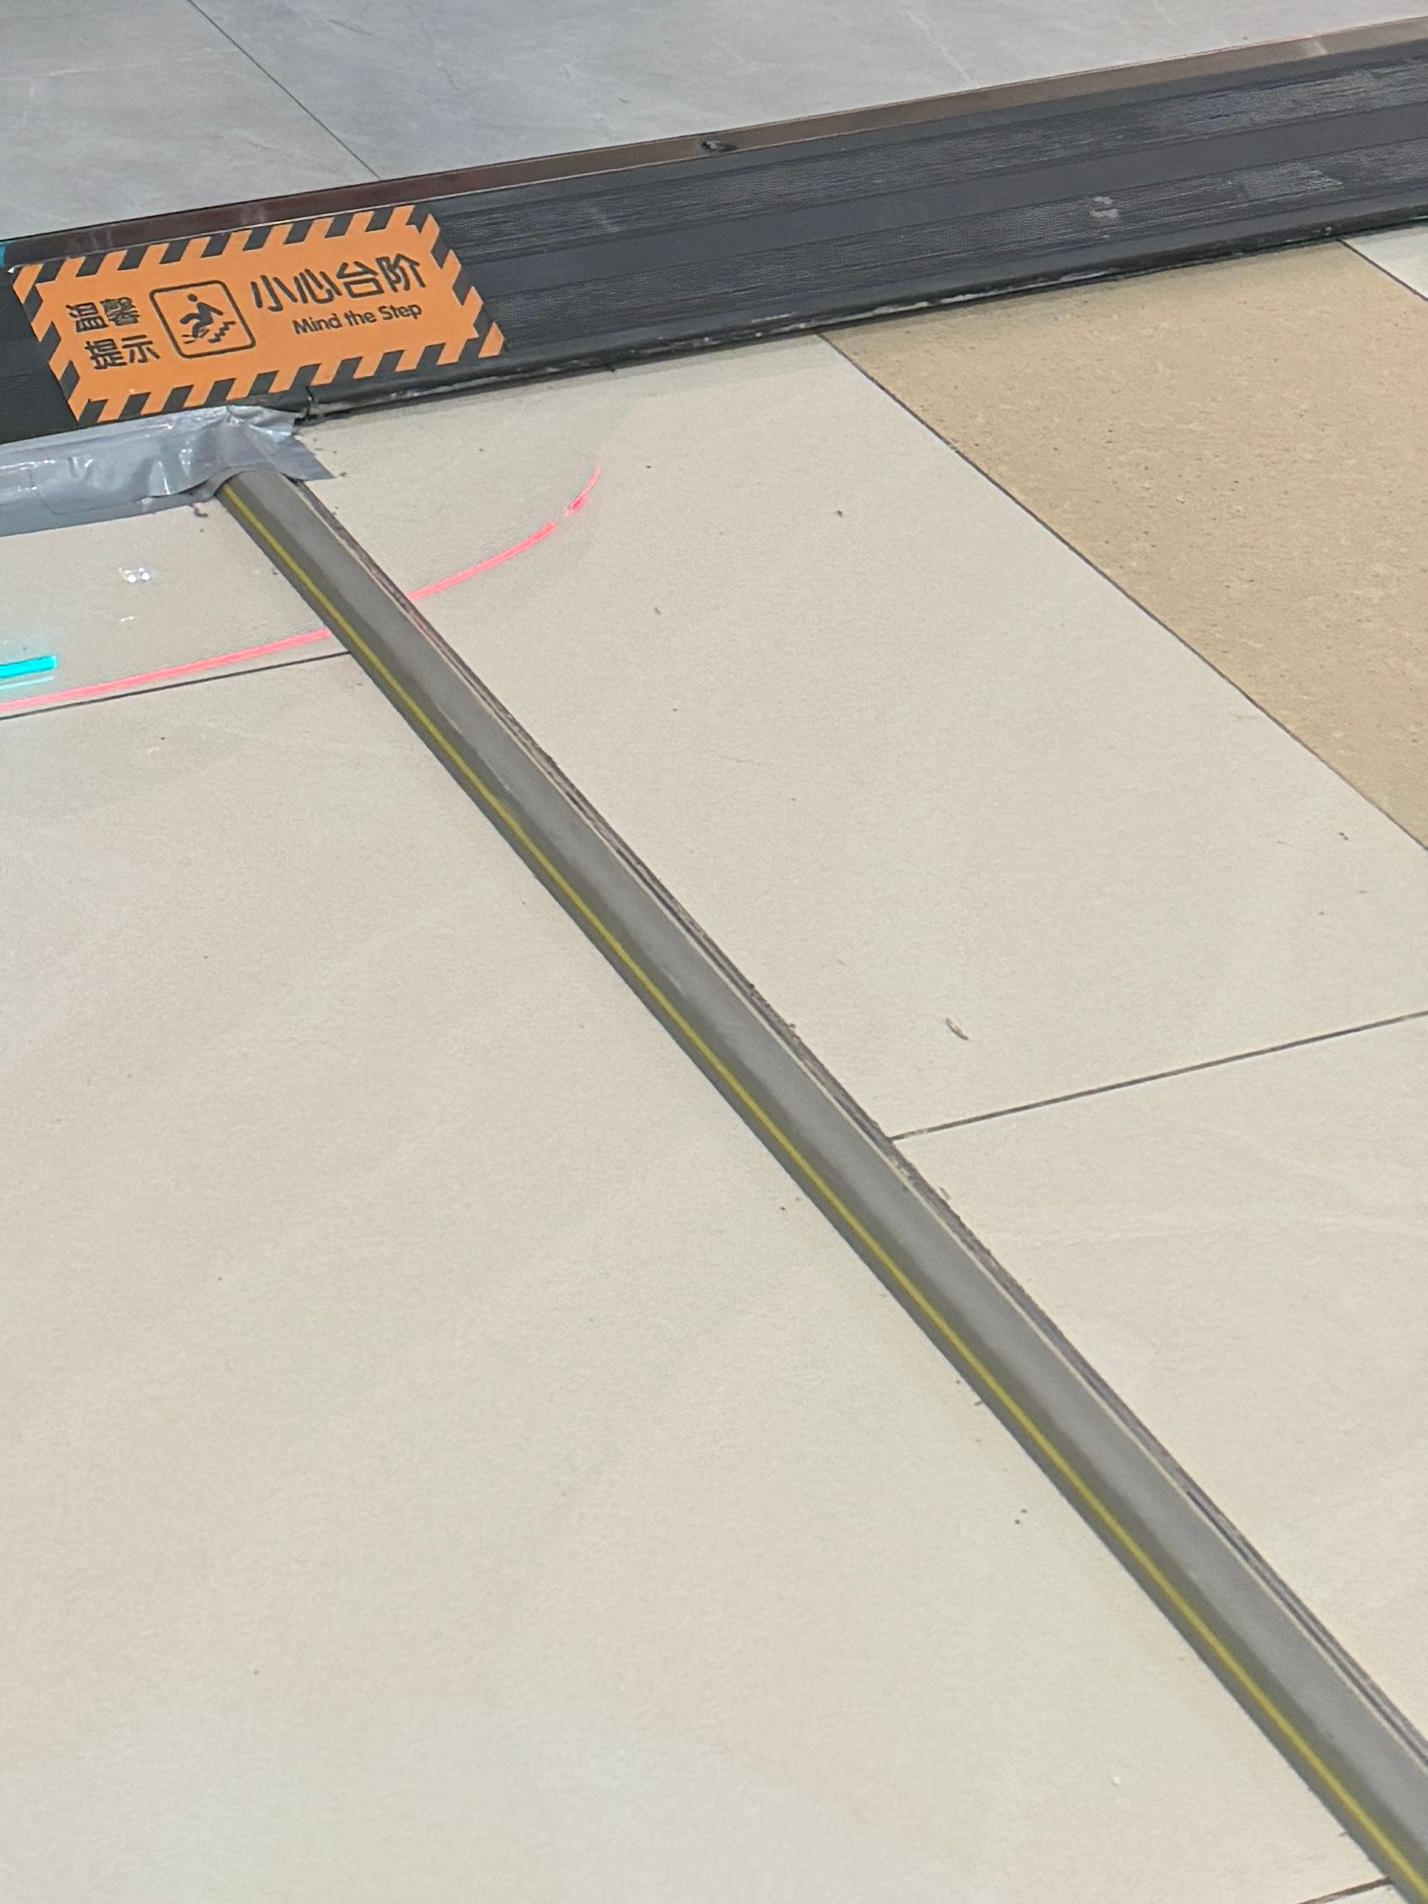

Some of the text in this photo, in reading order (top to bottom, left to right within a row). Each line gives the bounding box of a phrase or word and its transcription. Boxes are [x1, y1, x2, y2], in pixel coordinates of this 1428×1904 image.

[249, 253, 427, 312] 小心台阶
[65, 296, 142, 333] 温馨
[292, 302, 423, 336] Mind the Step
[84, 334, 161, 371] 提示
